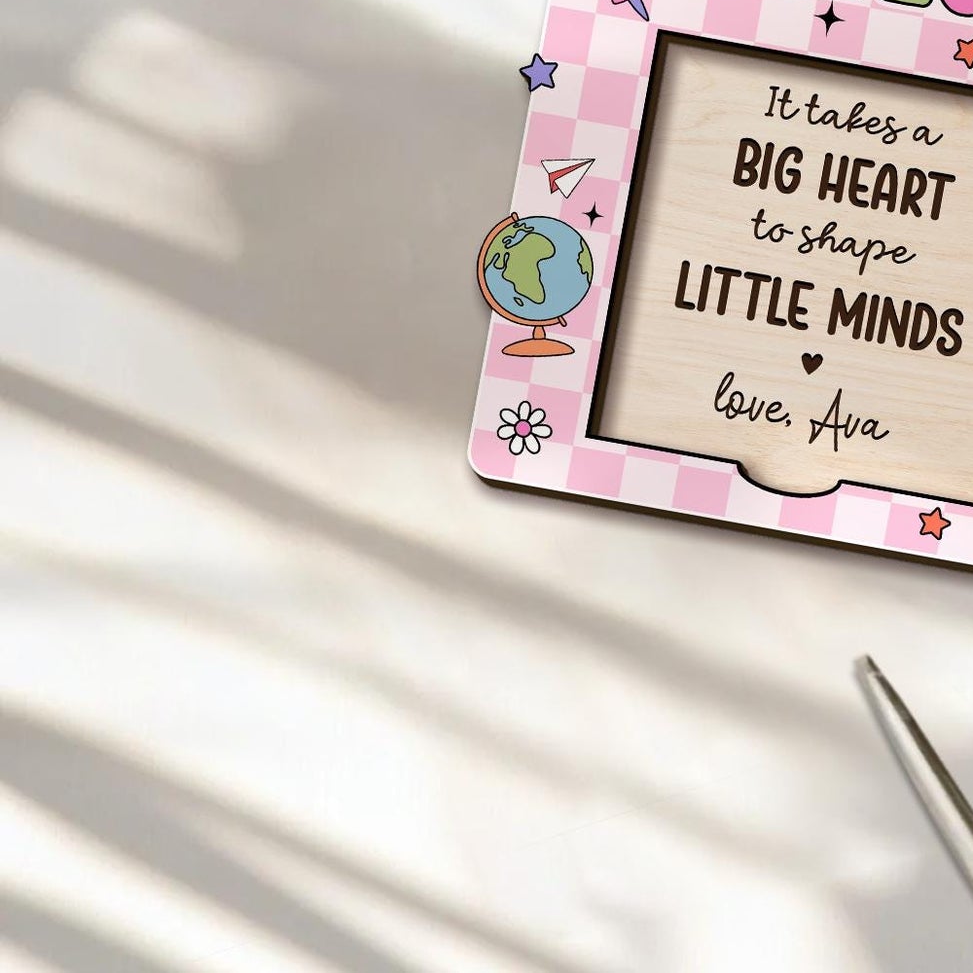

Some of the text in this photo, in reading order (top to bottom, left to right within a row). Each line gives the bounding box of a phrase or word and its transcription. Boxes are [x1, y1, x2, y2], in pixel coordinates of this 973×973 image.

[764, 85, 943, 147] It takes a
[733, 137, 956, 221] BIG HEART
[751, 208, 917, 275] to shape
[675, 260, 964, 357] LITTLE MINDS
[713, 372, 889, 452] love, Ava
